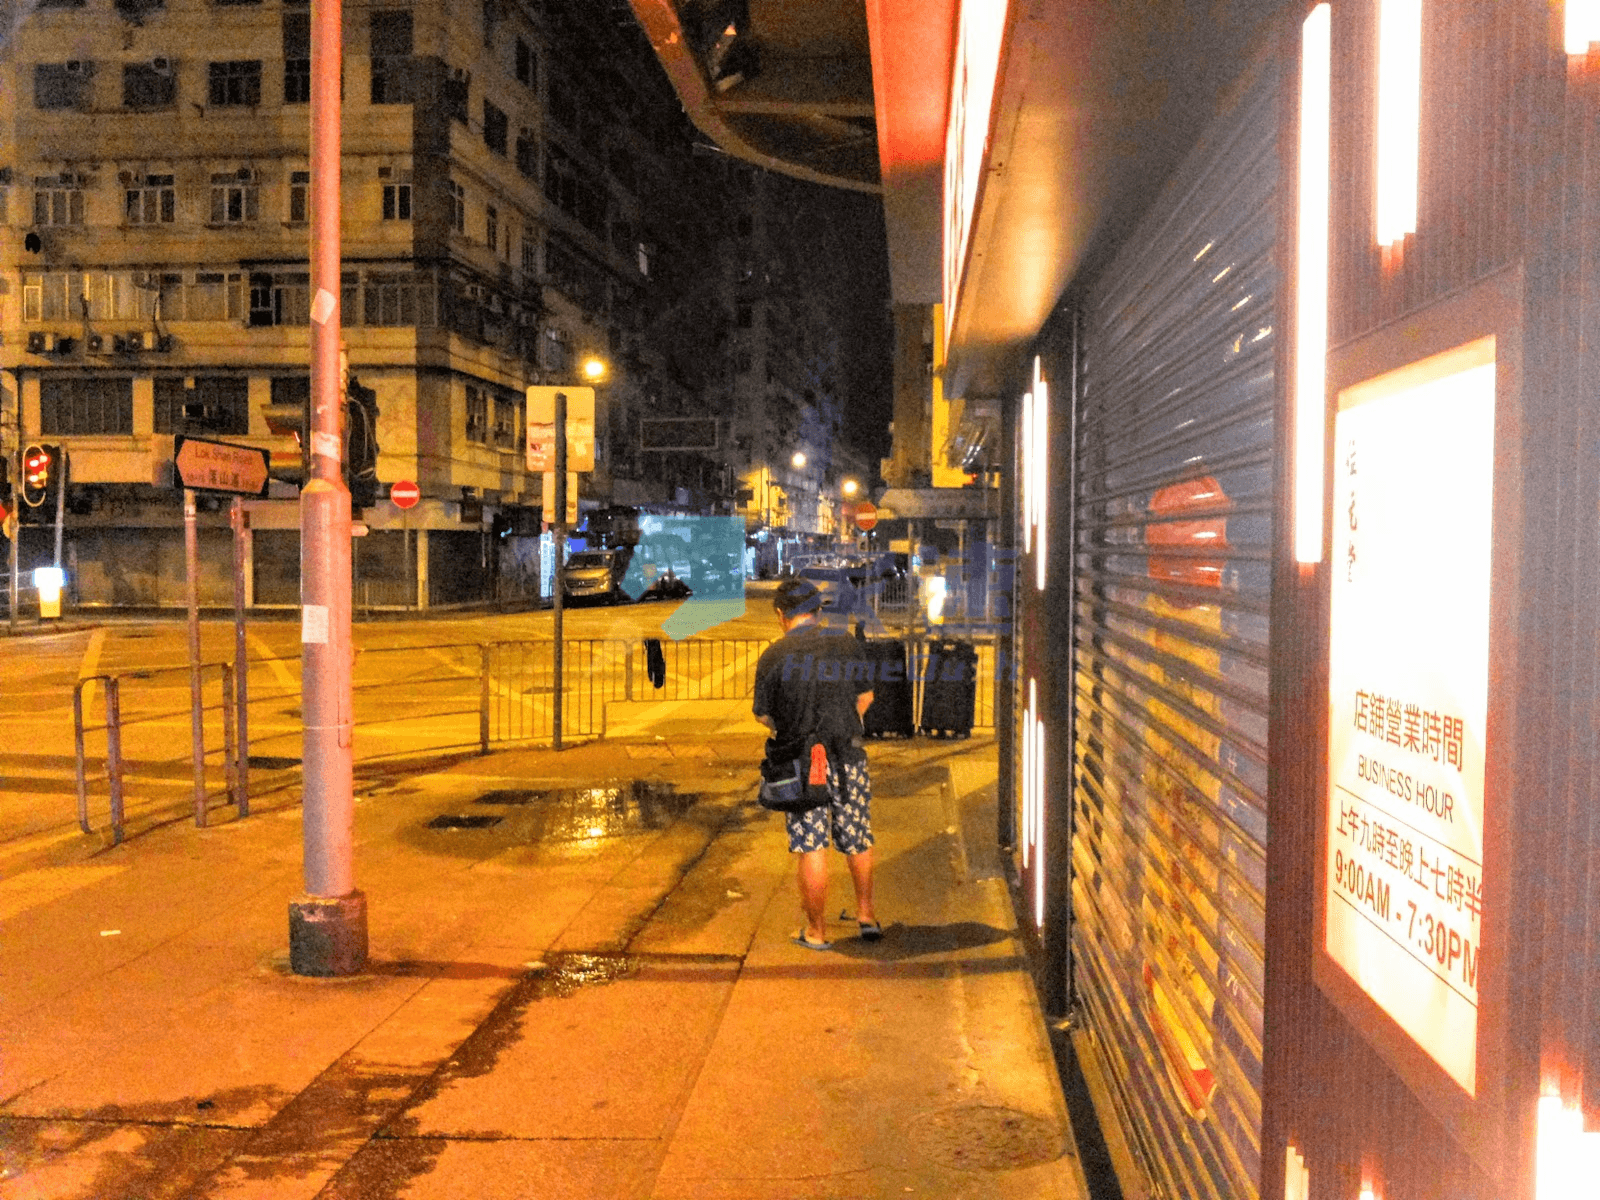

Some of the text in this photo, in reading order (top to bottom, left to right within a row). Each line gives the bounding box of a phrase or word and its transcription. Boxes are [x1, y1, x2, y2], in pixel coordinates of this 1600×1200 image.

[1354, 688, 1464, 772] 店舖營業時間
[1358, 753, 1454, 823] BUSINESS HOUR
[1335, 848, 1390, 922] 9:00AM
[1336, 799, 1483, 923] 上午九時至晚上七時半
